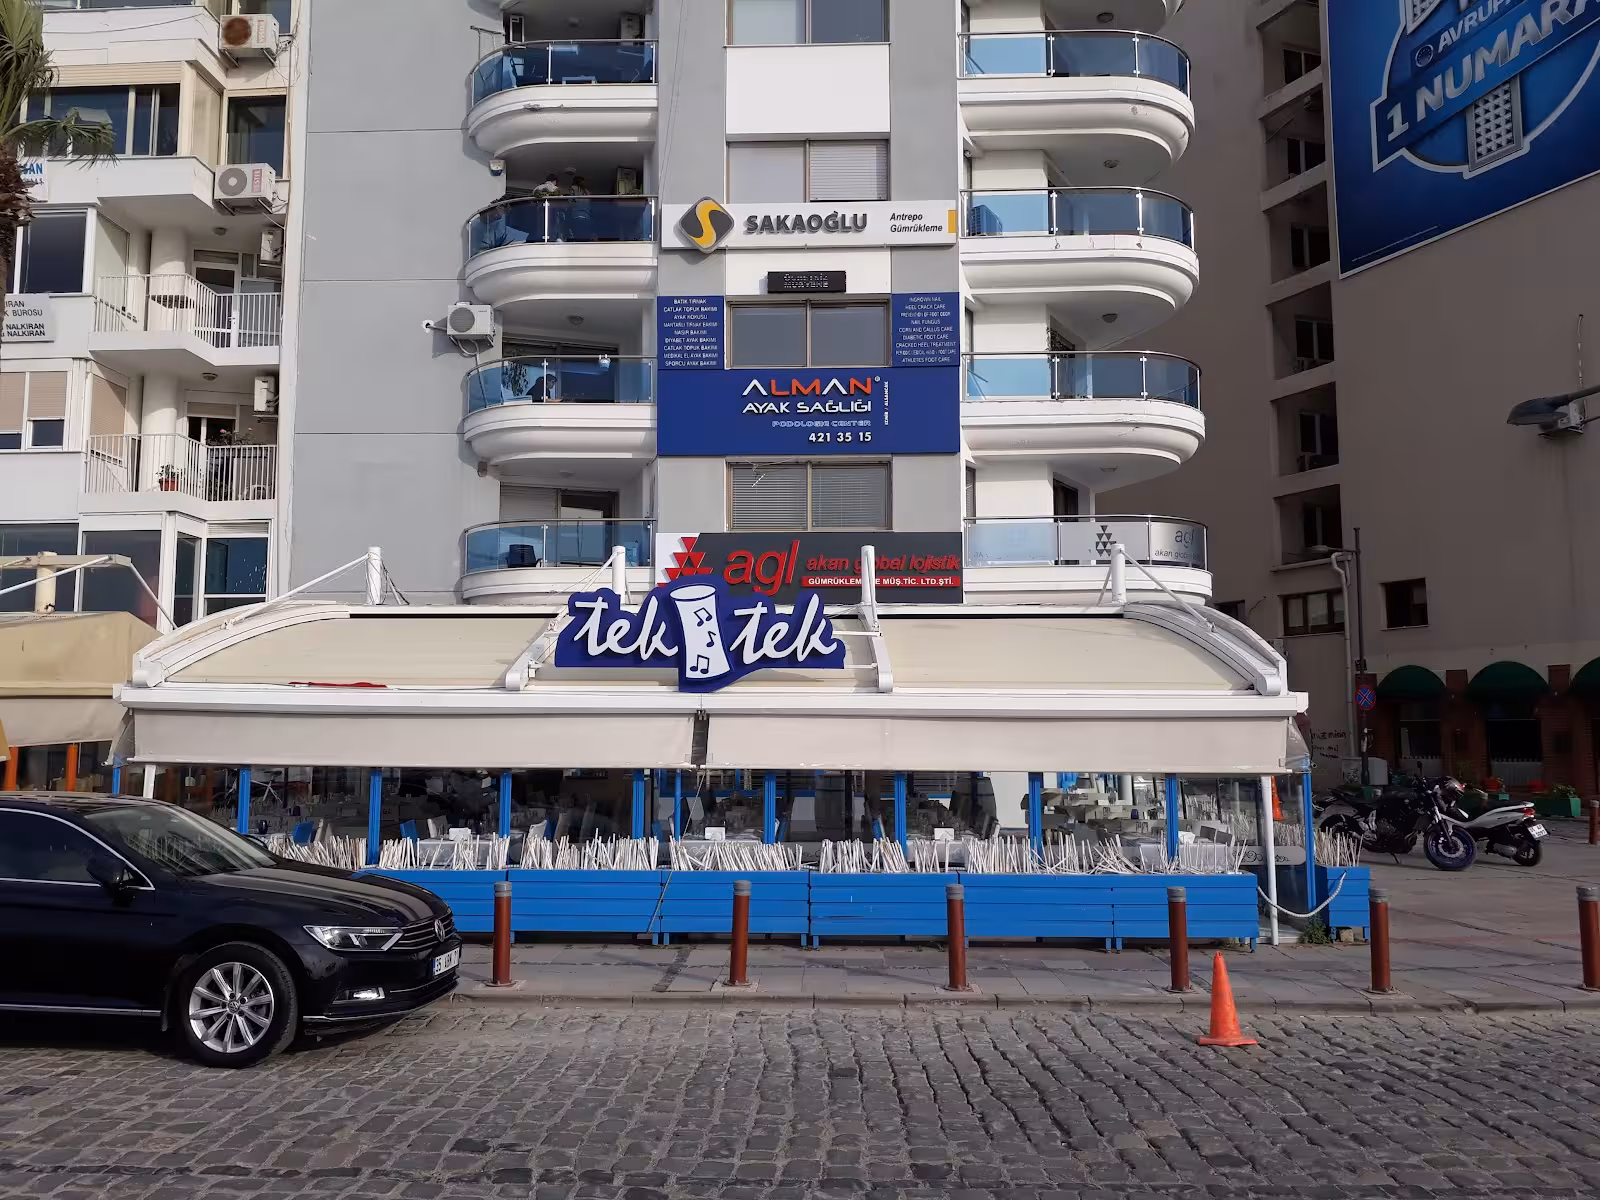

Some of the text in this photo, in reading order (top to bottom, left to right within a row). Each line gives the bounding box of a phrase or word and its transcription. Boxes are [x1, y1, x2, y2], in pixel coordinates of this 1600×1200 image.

[1438, 0, 1511, 53] AVRUP
[1387, 102, 1409, 142] 1
[746, 210, 868, 233] SAKAOĞLU
[890, 213, 923, 222] Antrepo
[890, 224, 943, 234] Gümrükleme
[742, 378, 872, 396] ALMAN
[742, 399, 872, 413] AYAK SAĞLIĞI
[809, 432, 872, 442] 421 35 15
[1174, 528, 1194, 548] agl
[1154, 549, 1173, 557] akan
[723, 539, 800, 596] agl
[806, 553, 960, 575] akan gbal lojistik
[574, 593, 838, 665] tek tek
